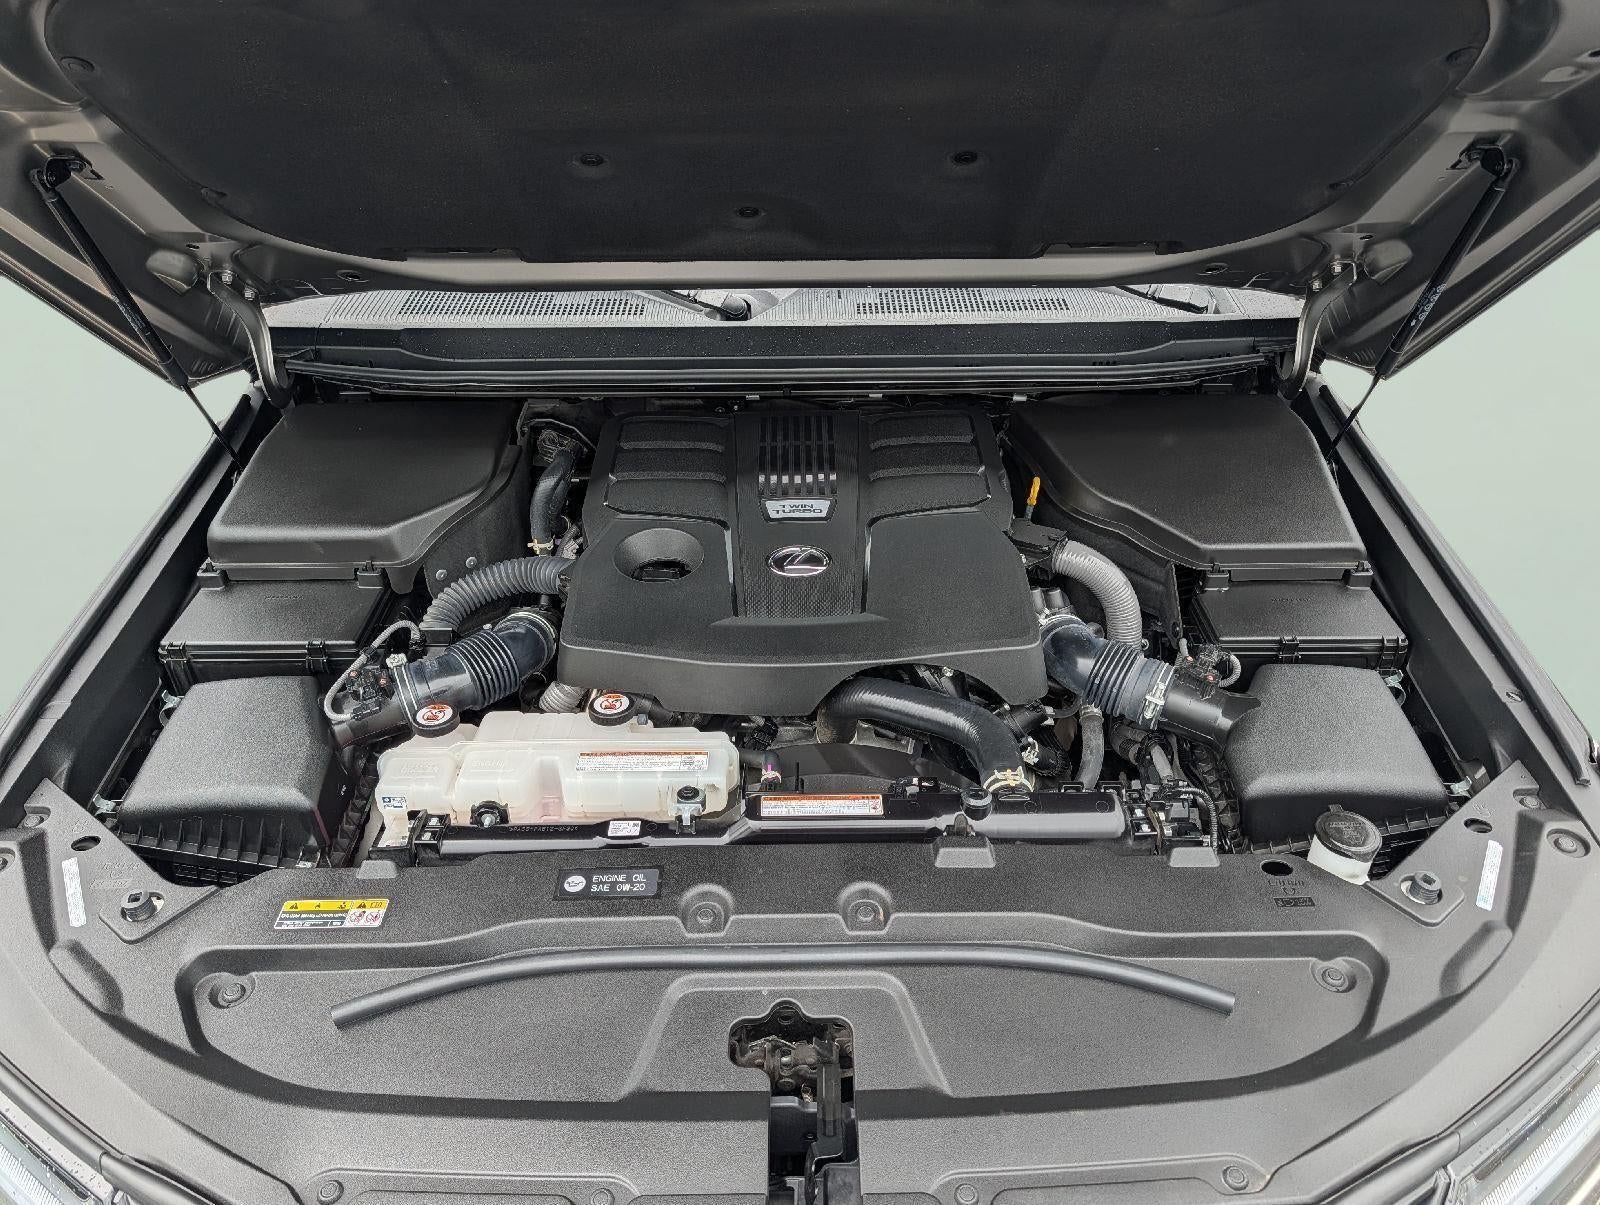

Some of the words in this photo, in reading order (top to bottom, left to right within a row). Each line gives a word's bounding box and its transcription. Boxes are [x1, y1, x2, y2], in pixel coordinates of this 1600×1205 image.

[592, 874, 627, 882] ENGINE
[632, 873, 647, 881] OIL
[591, 883, 610, 892] SAE
